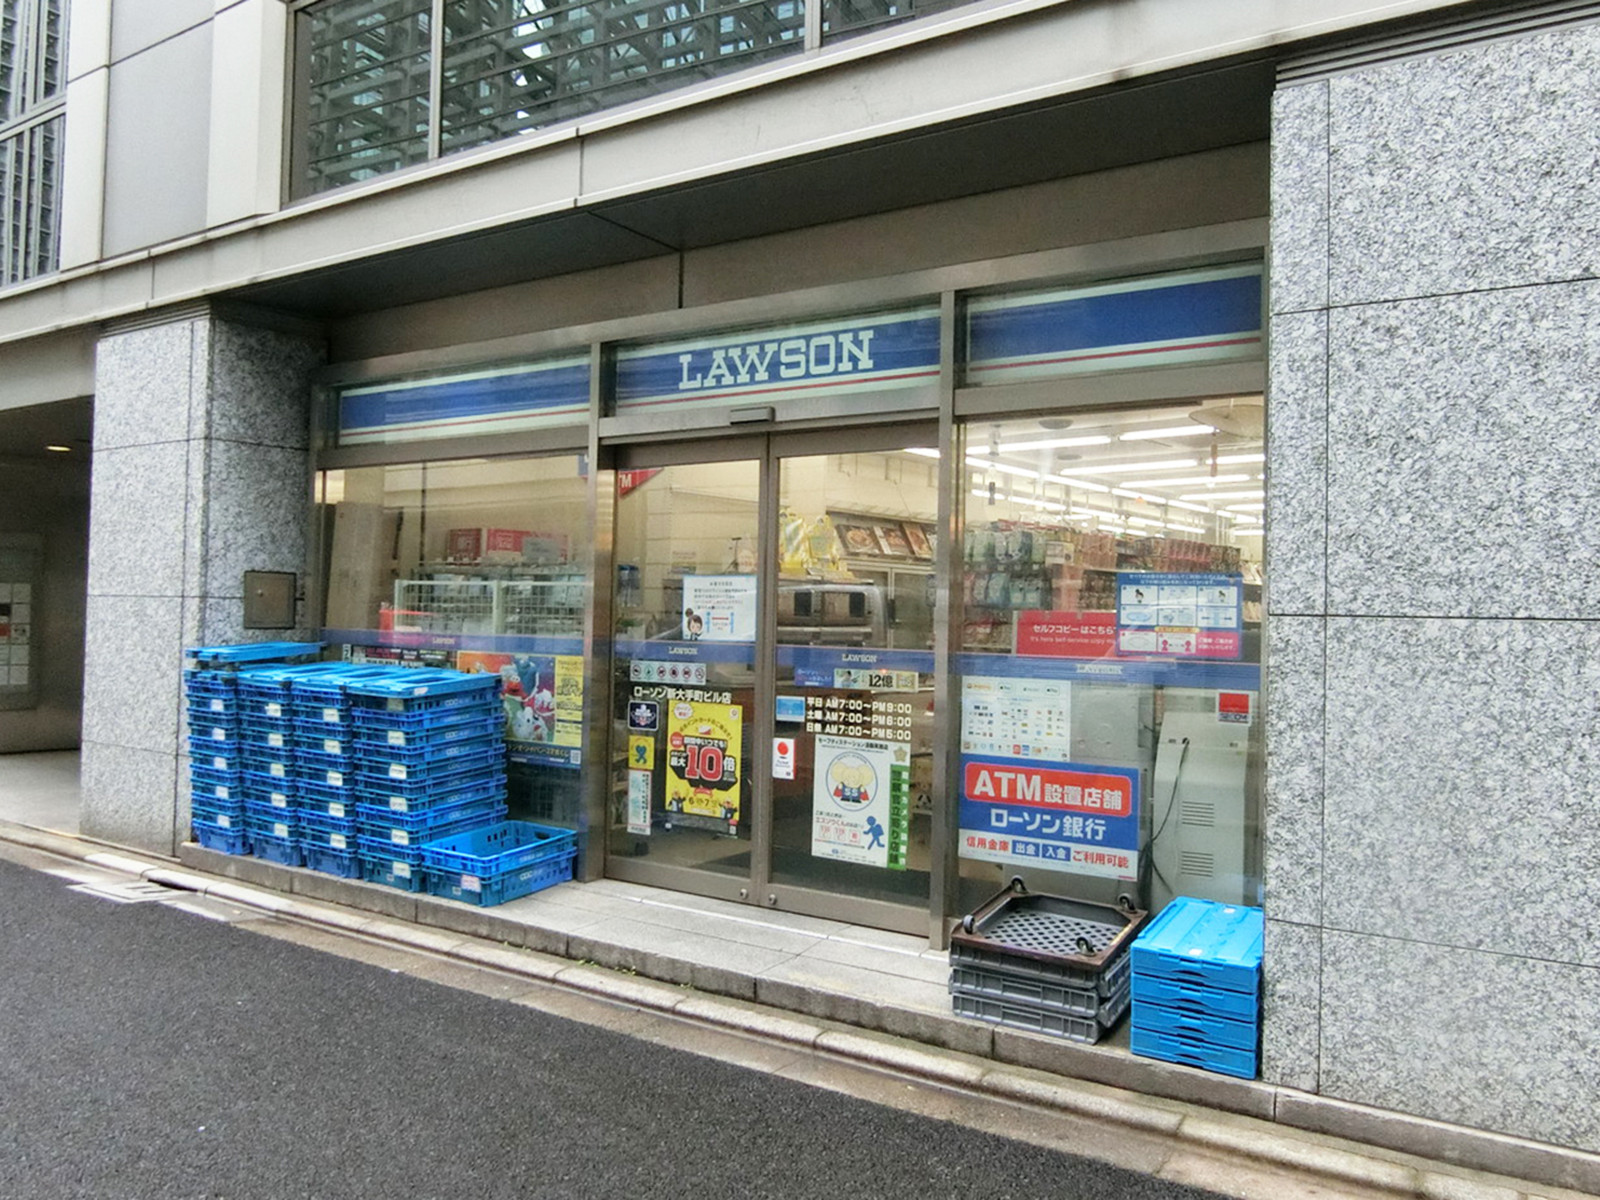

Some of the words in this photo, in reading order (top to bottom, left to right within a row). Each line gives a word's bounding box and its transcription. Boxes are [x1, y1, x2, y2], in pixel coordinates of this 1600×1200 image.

[678, 329, 875, 390] LAWSON
[634, 686, 732, 704] ローソン新大手町ビル店
[990, 808, 1107, 841] ローソン銀行
[966, 835, 1010, 852] 信用金庫
[1015, 842, 1037, 856] 出金
[1045, 847, 1067, 860] 入金
[1072, 850, 1129, 869] ご利用可能
